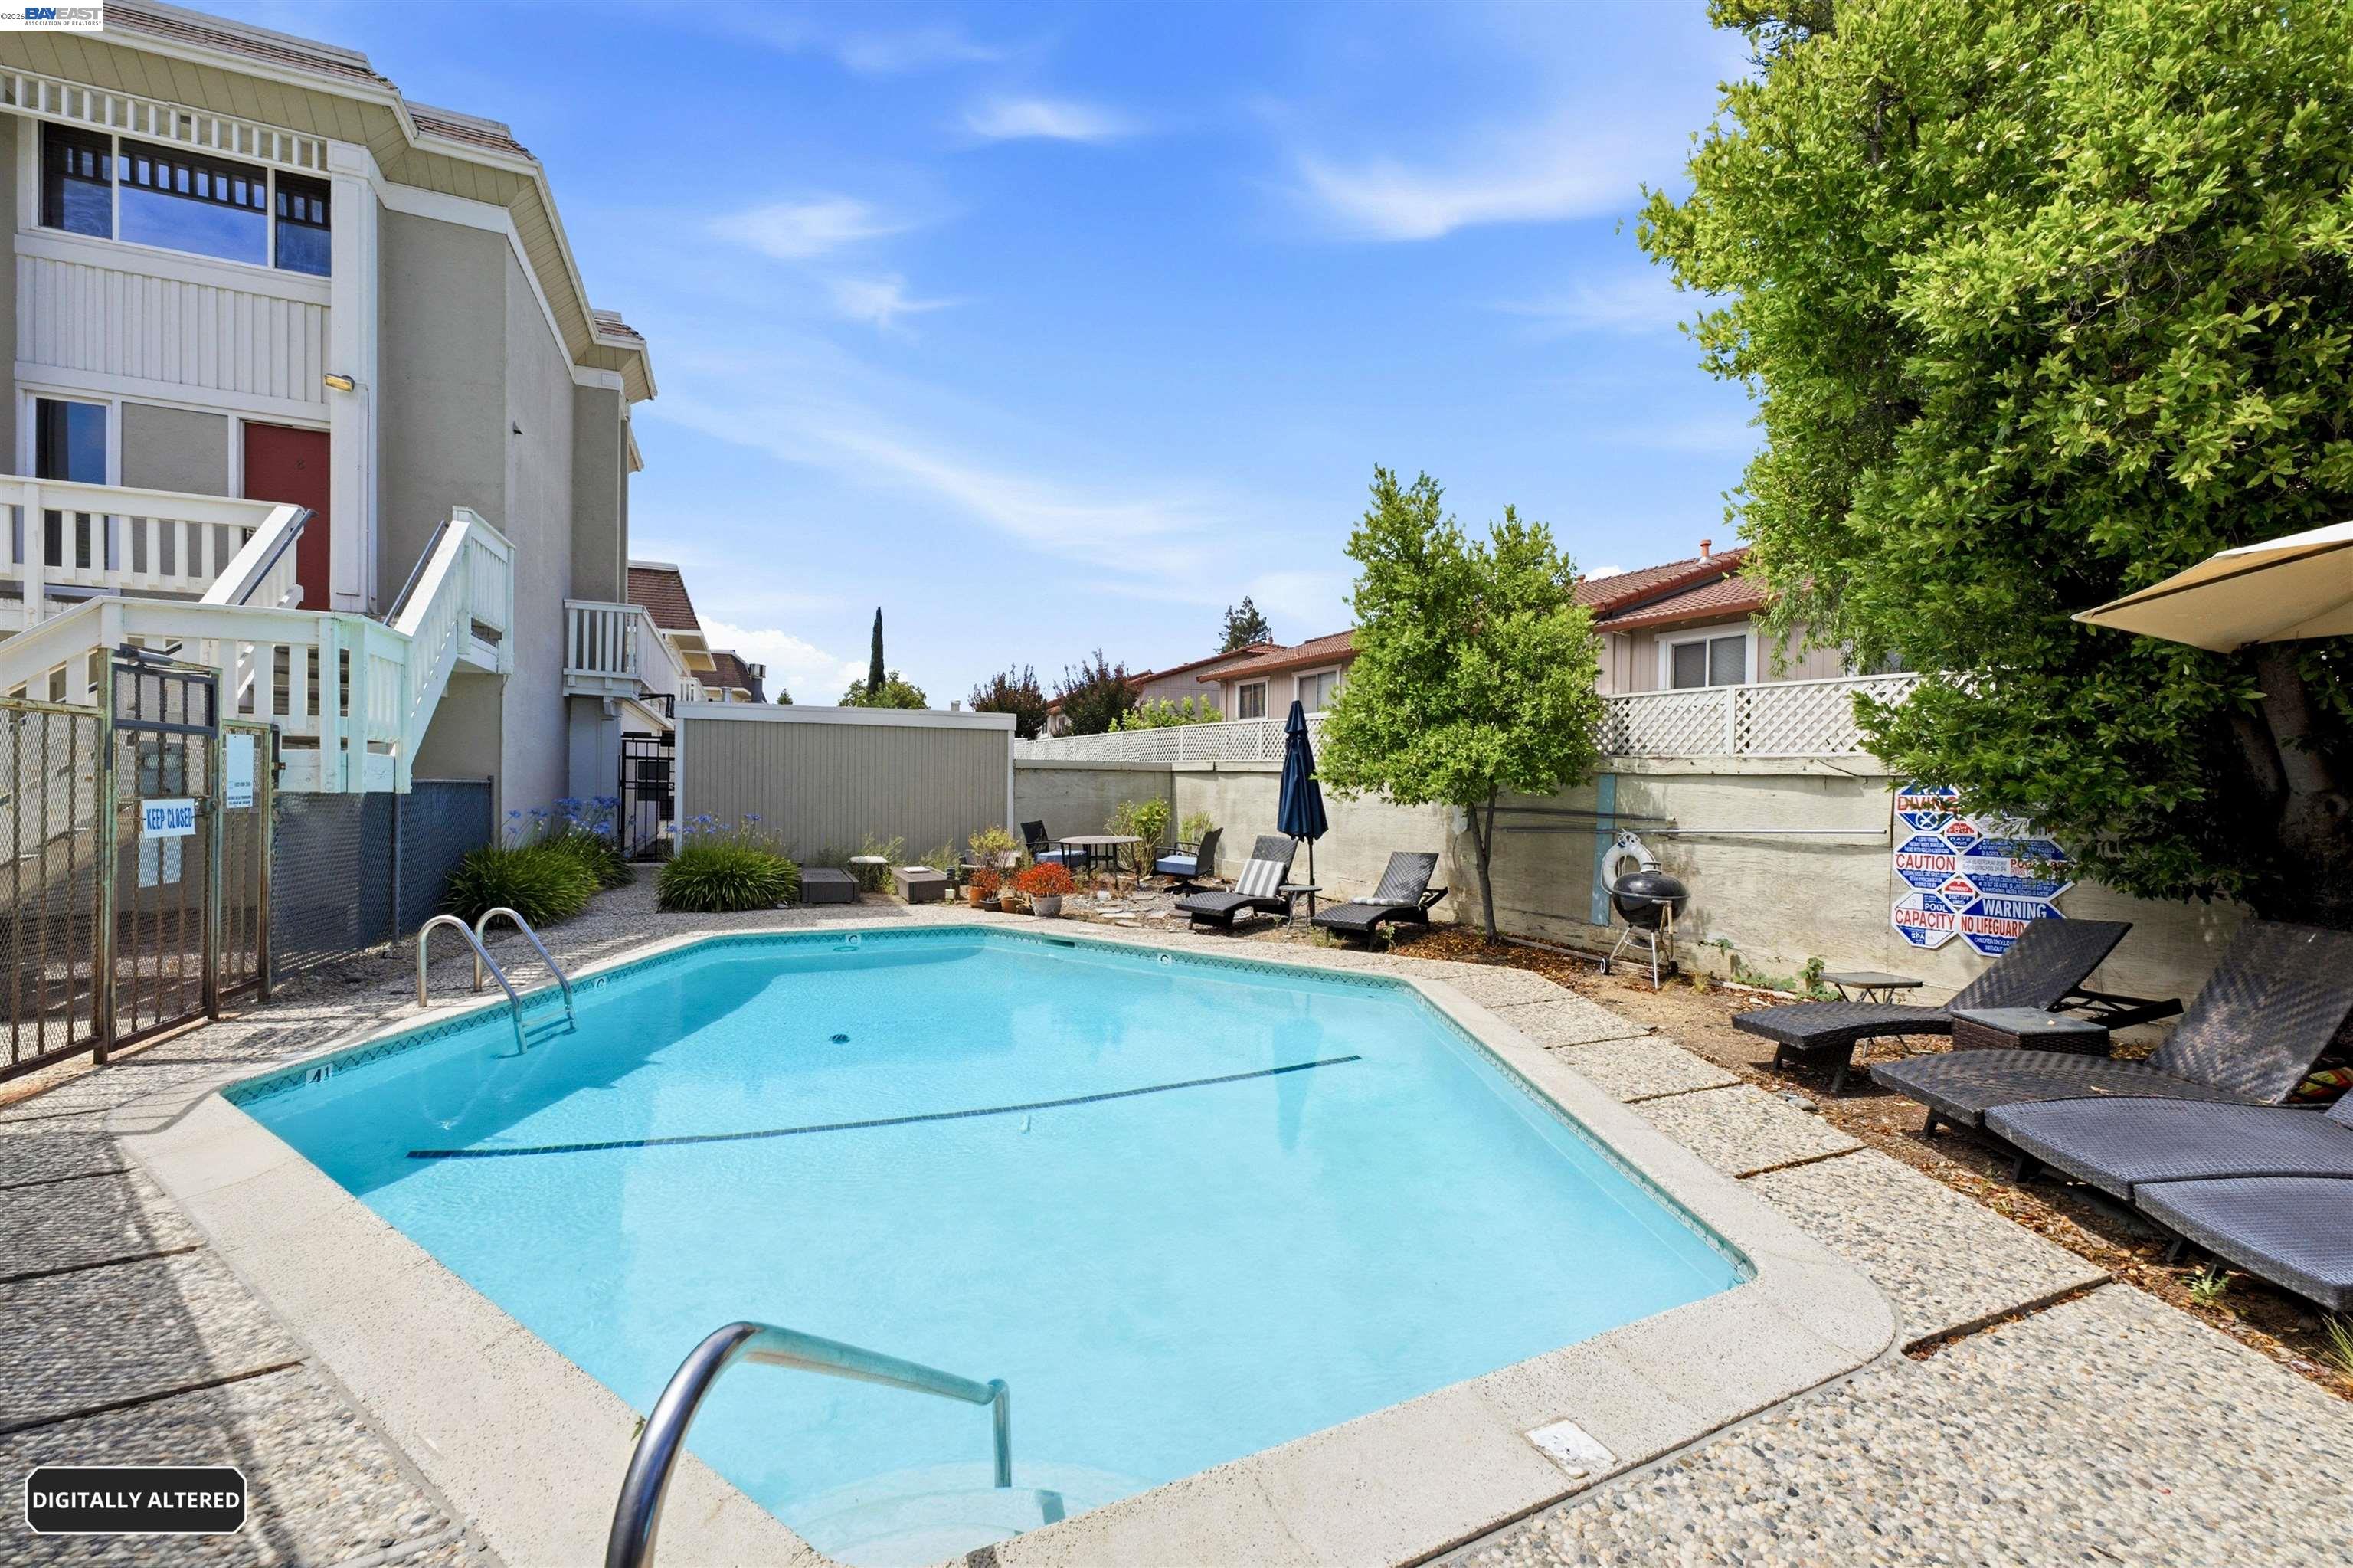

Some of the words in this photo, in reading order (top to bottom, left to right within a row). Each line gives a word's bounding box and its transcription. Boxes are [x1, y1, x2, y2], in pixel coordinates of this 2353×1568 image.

[146, 809, 165, 830] KEEP
[167, 807, 192, 828] CLOSED
[1896, 854, 1955, 870] CAUTION
[1924, 903, 1948, 912] POOL
[1982, 899, 2047, 918] WARNING
[1895, 909, 1955, 930] CAPACITY
[1961, 916, 1974, 932] NO
[1976, 918, 2025, 937] LIFEGUARD
[1911, 931, 1925, 940] SPA
